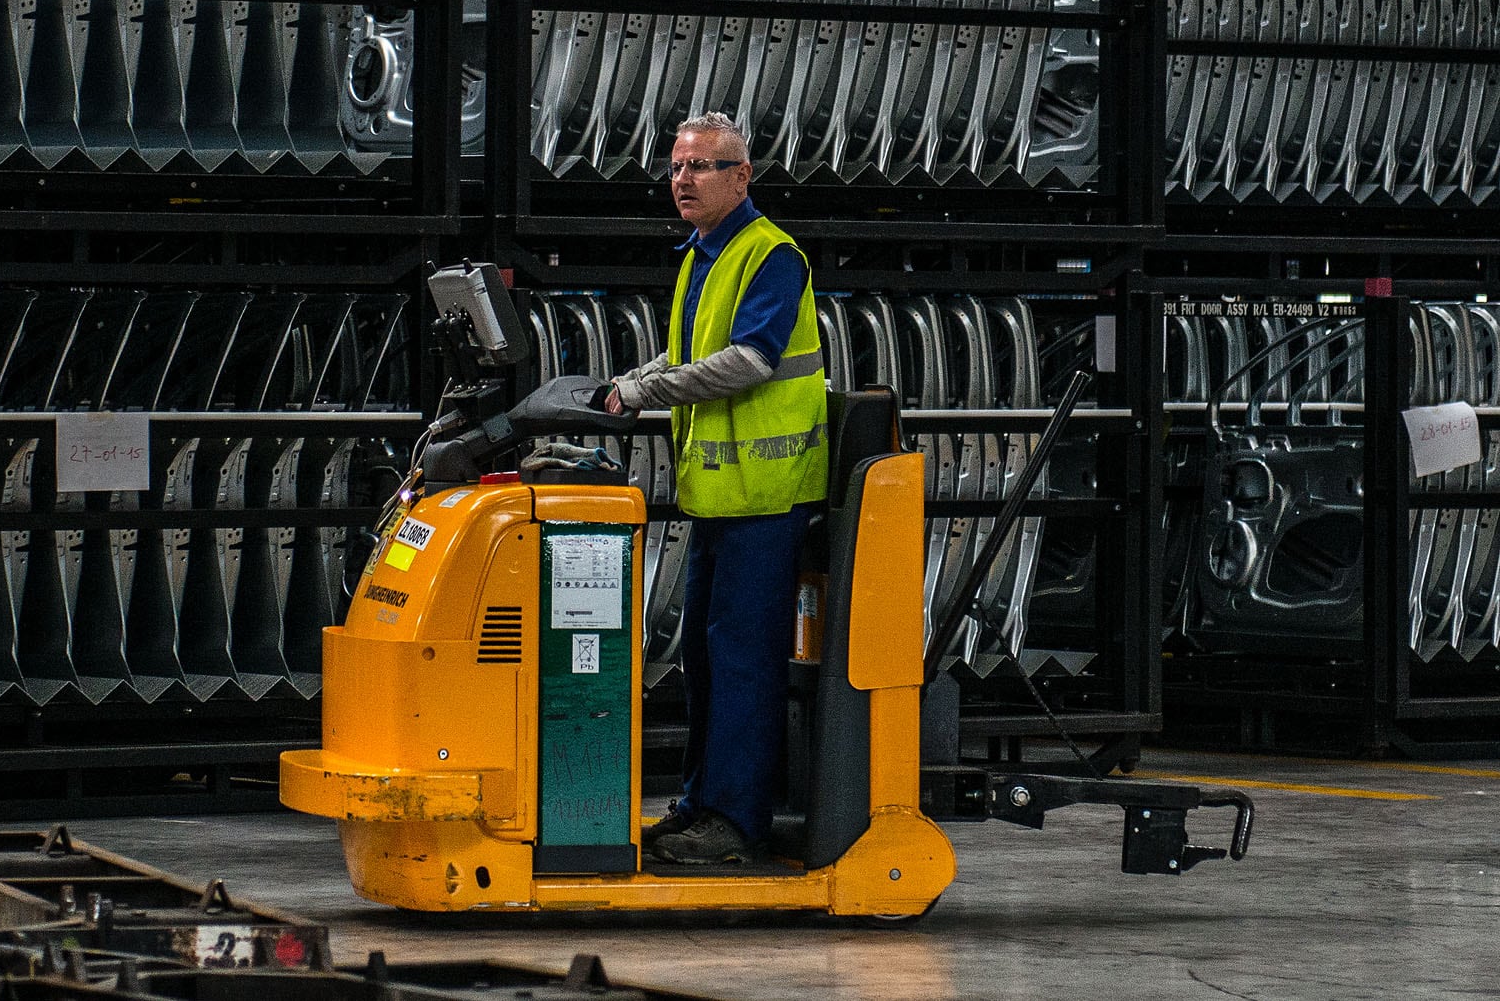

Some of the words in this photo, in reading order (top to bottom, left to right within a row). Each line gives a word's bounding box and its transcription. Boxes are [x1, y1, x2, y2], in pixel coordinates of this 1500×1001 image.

[1181, 303, 1195, 315] FRT
[1201, 303, 1222, 316] DOOR
[1227, 304, 1249, 316] ASSY
[1253, 304, 1269, 316] R/L
[1273, 304, 1313, 316] EB-24499
[1318, 304, 1330, 317] V2
[70, 445, 144, 463] 27-01-15
[364, 584, 409, 608] JUNGHEINRICH
